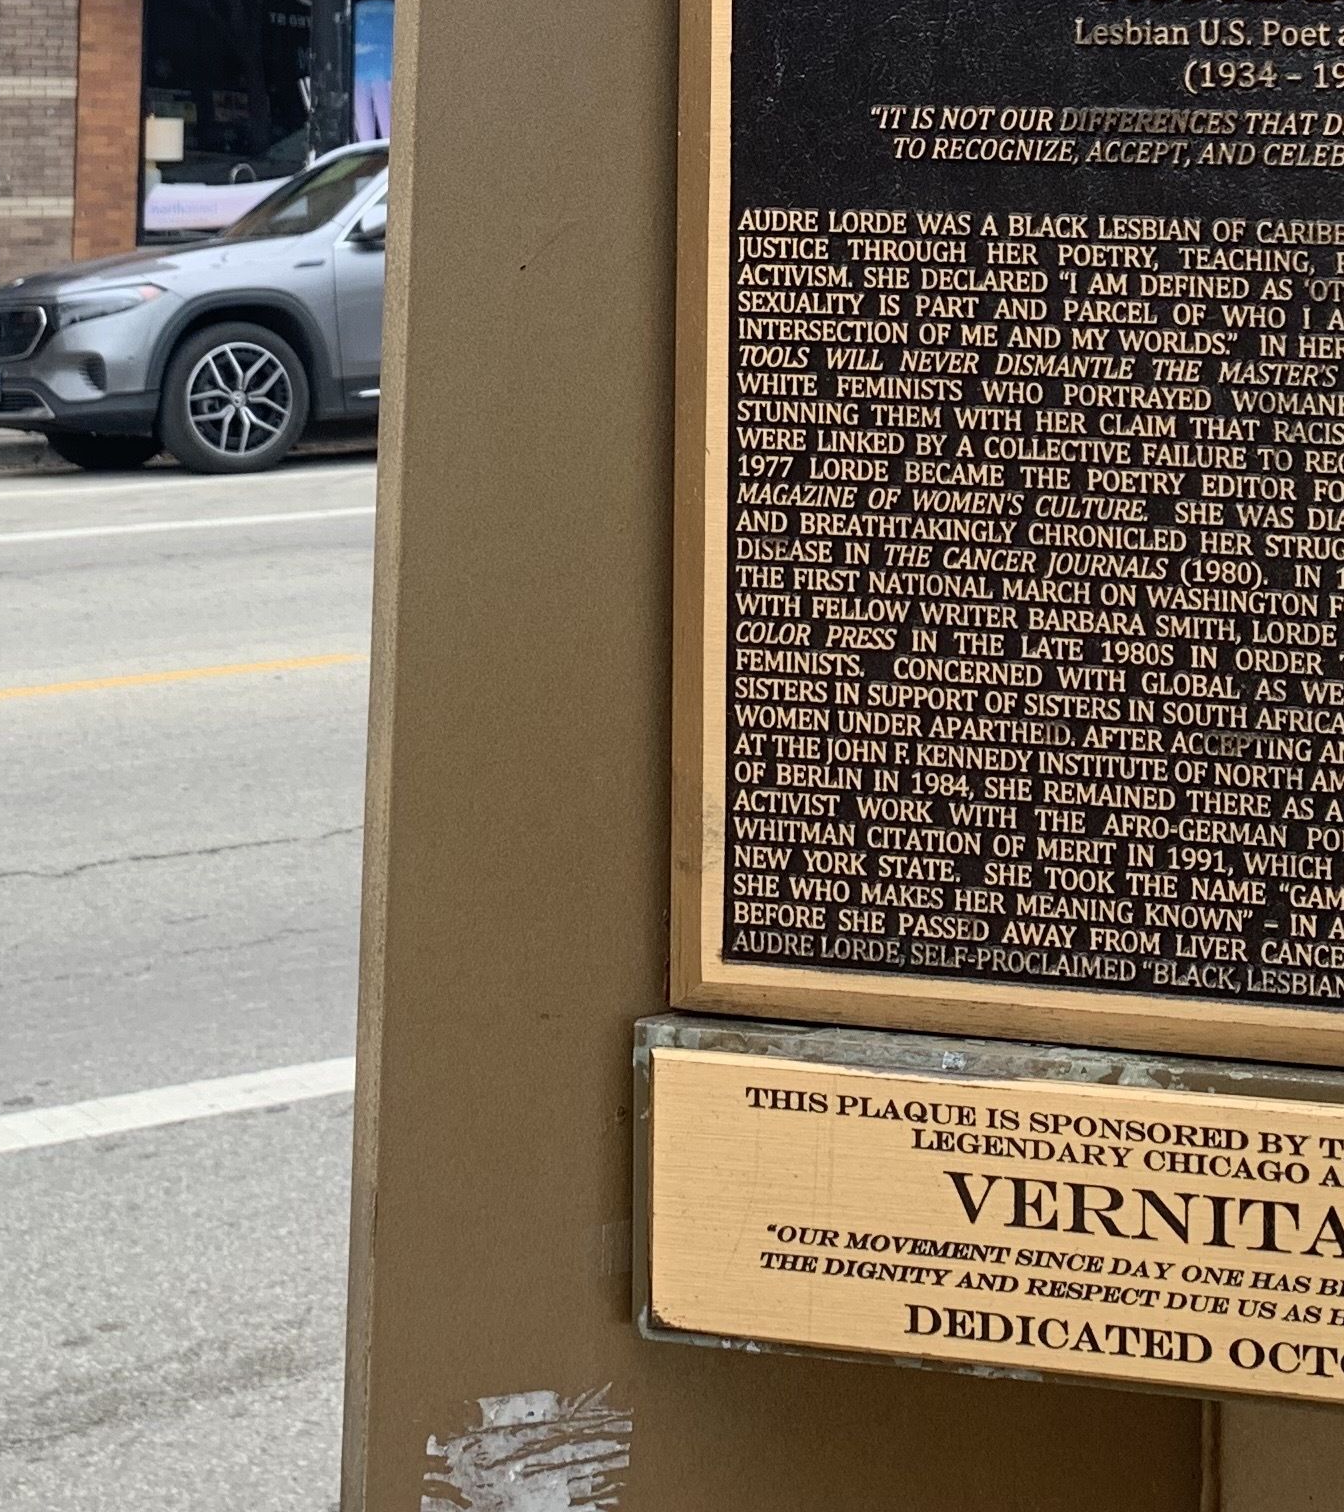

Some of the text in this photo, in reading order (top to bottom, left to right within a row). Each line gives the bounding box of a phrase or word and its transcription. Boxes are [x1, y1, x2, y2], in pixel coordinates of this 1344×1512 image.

[1074, 18, 1190, 46] Lesbian
[1199, 18, 1252, 46] U.S.
[1262, 19, 1331, 47] Poet
[1184, 60, 1278, 94] (1934
[870, 104, 907, 130] “IT
[910, 104, 936, 130] IS
[939, 105, 996, 131] NOT
[999, 106, 1055, 132] OUR
[1059, 106, 1238, 134] DIFFERENCES
[1244, 110, 1319, 136] THAT
[893, 137, 927, 160] TO
[931, 137, 1079, 163] RECOGNIZE,
[1084, 140, 1191, 167] ACCEPT,
[1196, 142, 1256, 166] AND
[737, 208, 819, 232] AUDRE
[828, 210, 907, 234] LORDE
[916, 212, 971, 236] WAS
[979, 214, 999, 236] A
[1008, 215, 1089, 239] BLACK
[1098, 217, 1201, 241] LESBIAN
[1212, 218, 1246, 243] OF
[736, 372, 818, 396] WHITE
[836, 375, 963, 401] FEMINISTS
[981, 380, 1044, 404] WHO
[1063, 384, 1212, 411] PORTRAYED
[735, 648, 865, 677] FEMINISTS.
[893, 657, 1043, 687] CONCERNED
[1057, 666, 1126, 693] WITH
[1141, 671, 1241, 699] GLOBAL
[1254, 678, 1287, 702] AS
[732, 790, 841, 819] ACTIVIST
[857, 797, 934, 824] WORK
[949, 802, 1017, 829] WITH
[1034, 808, 1086, 834] THE
[1102, 814, 1288, 847] AFRO-GERMAN
[745, 1086, 829, 1114] THIS
[835, 1095, 977, 1127] PLAQUE
[985, 1108, 1020, 1131] IS
[1029, 1113, 1249, 1151] SPONSORED
[1257, 1131, 1309, 1157] BY
[911, 1128, 1134, 1168] LEGENDARY
[1143, 1150, 1310, 1184] CHICAGO
[766, 1224, 840, 1248] “OUR
[843, 1232, 1012, 1264] MOVEMENT
[1014, 1248, 1105, 1274] SINCE
[1107, 1257, 1177, 1280] DAY
[1181, 1265, 1245, 1288] ONE
[1248, 1271, 1312, 1294] HAS
[760, 1251, 820, 1274] THE
[821, 1257, 954, 1286] DIGNITY
[954, 1272, 1020, 1293] AND
[1024, 1278, 1161, 1308] RESPECT
[1163, 1292, 1231, 1315] DUE
[1237, 1299, 1278, 1320] US
[1280, 1304, 1323, 1324] AS
[903, 1305, 1213, 1363] DEDICATED
